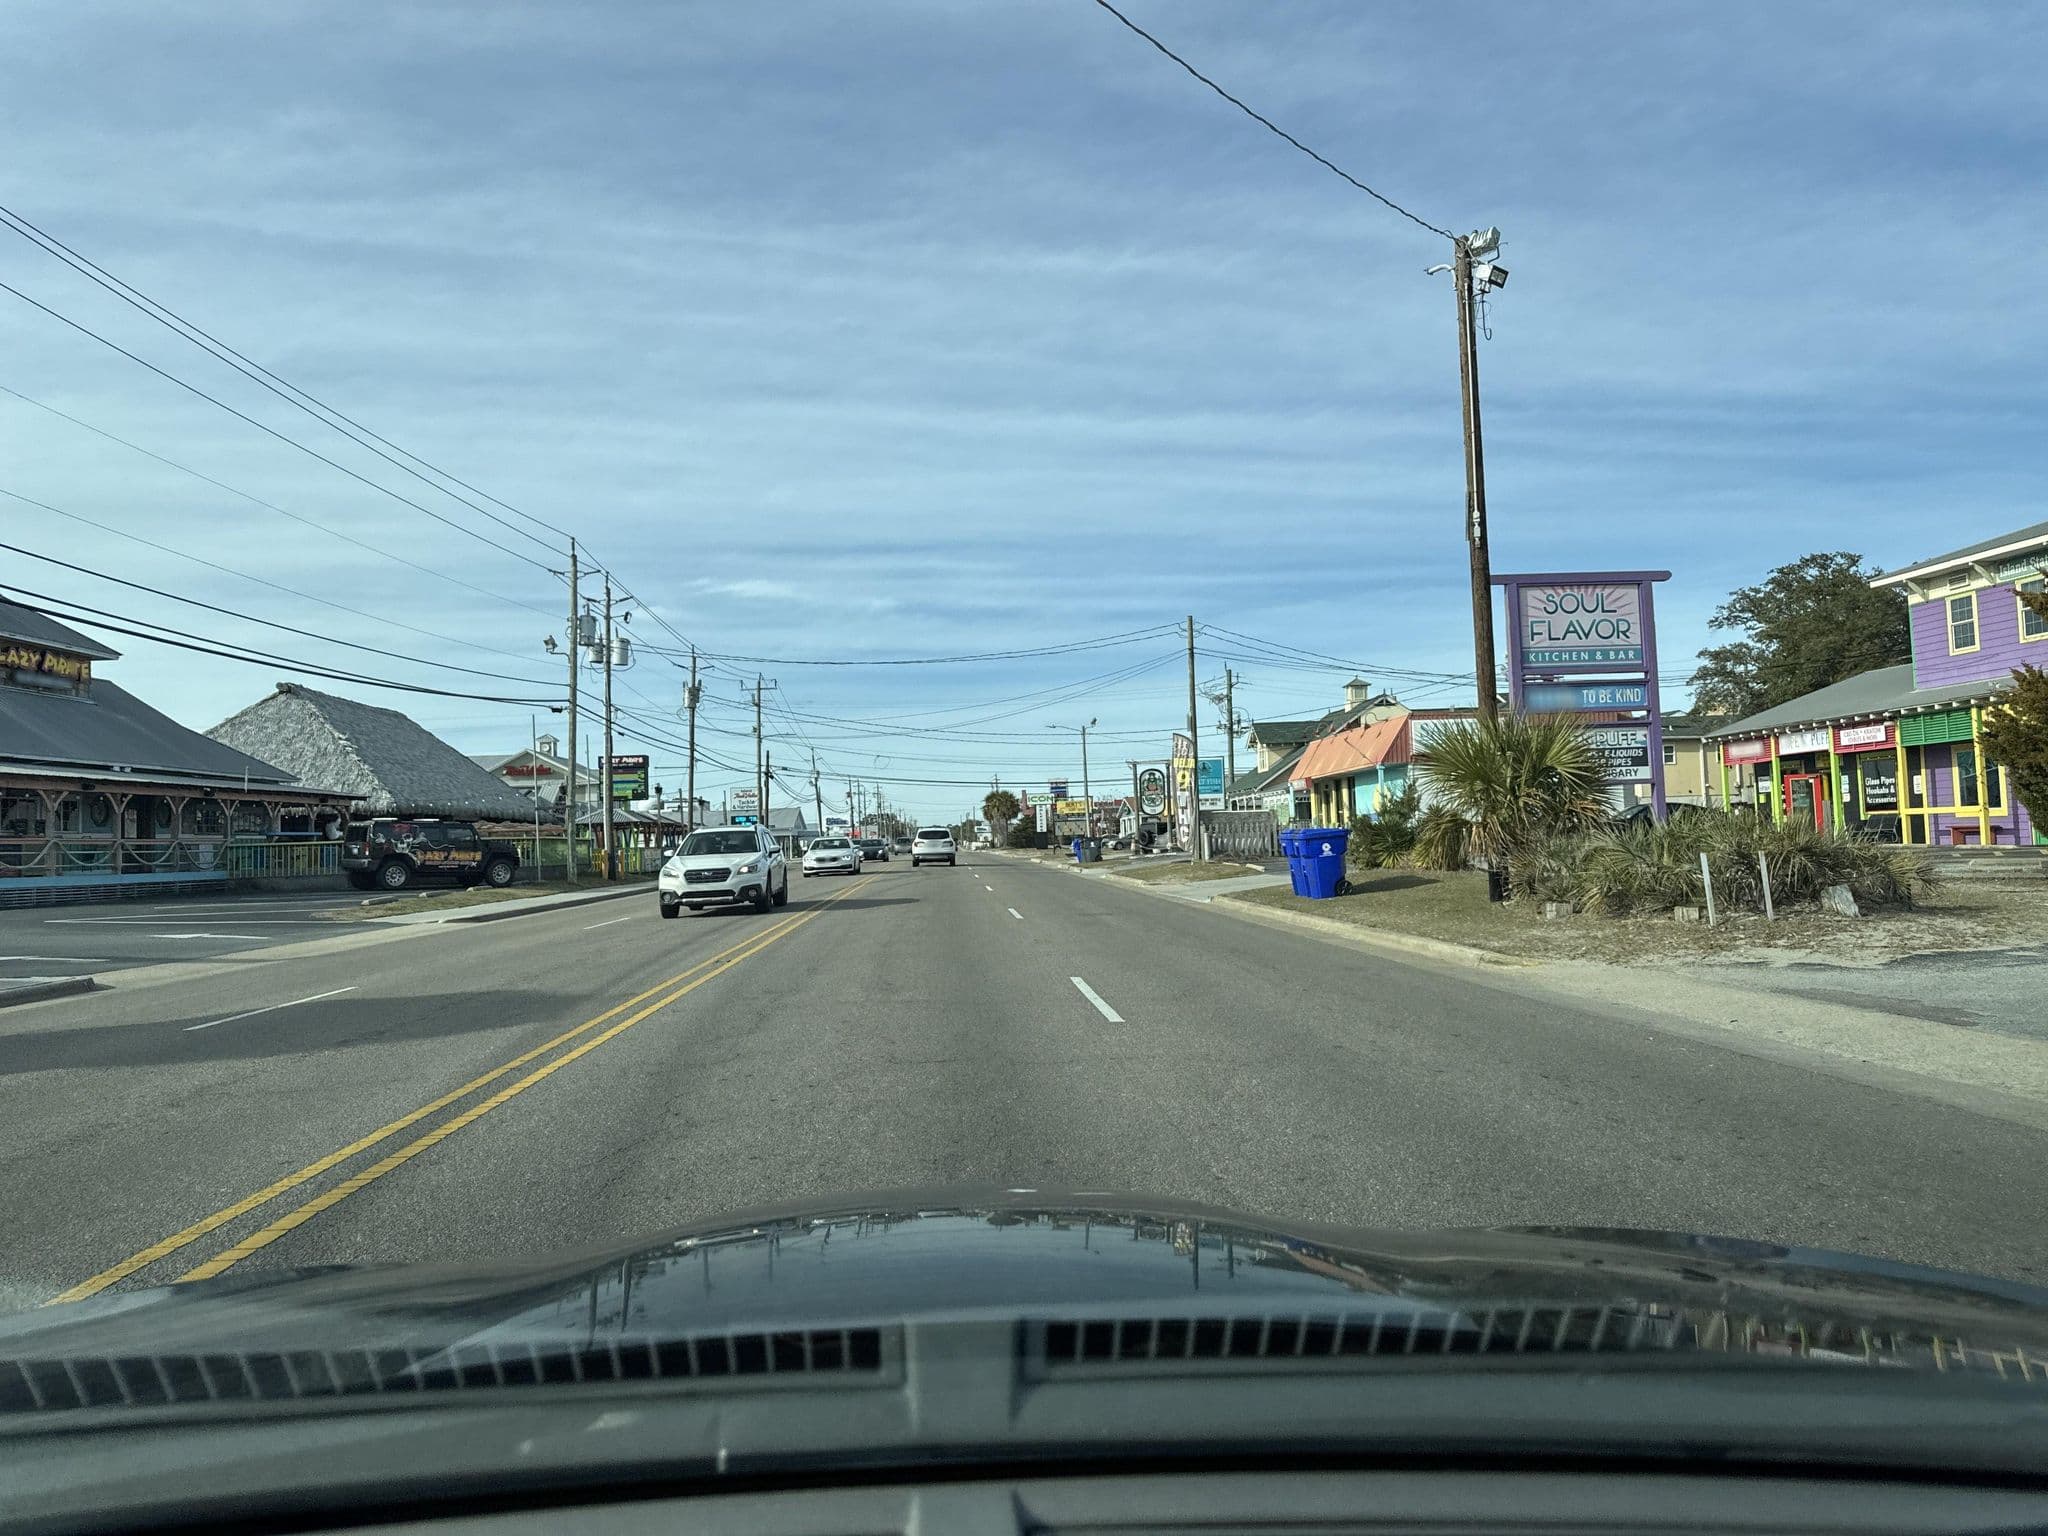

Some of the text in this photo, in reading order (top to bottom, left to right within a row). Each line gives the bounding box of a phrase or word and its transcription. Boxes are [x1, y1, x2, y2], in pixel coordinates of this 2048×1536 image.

[1999, 559, 2027, 577] Island
[1543, 592, 1617, 615] SOUL
[1530, 618, 1631, 641] FLAVOR
[1529, 650, 1635, 662] KITCHEN & BAR
[1582, 688, 1641, 704] TO BE KIND
[1596, 730, 1637, 746] PUFF
